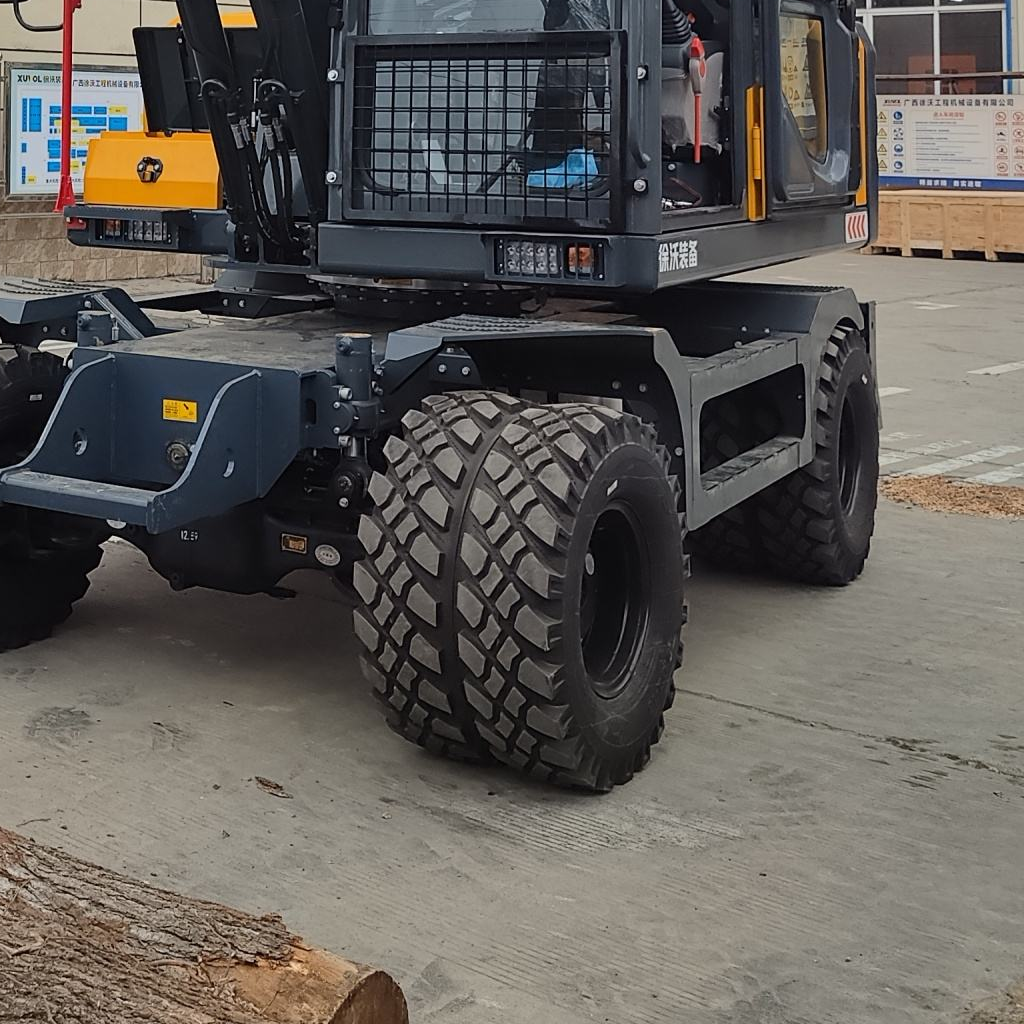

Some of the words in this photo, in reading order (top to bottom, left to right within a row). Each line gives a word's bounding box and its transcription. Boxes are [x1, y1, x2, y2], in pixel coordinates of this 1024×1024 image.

[43, 75, 61, 84] 徐沃装
[73, 79, 140, 88] 广西徐沃工程机械设备有限
[658, 239, 698, 273] 徐沃装备
